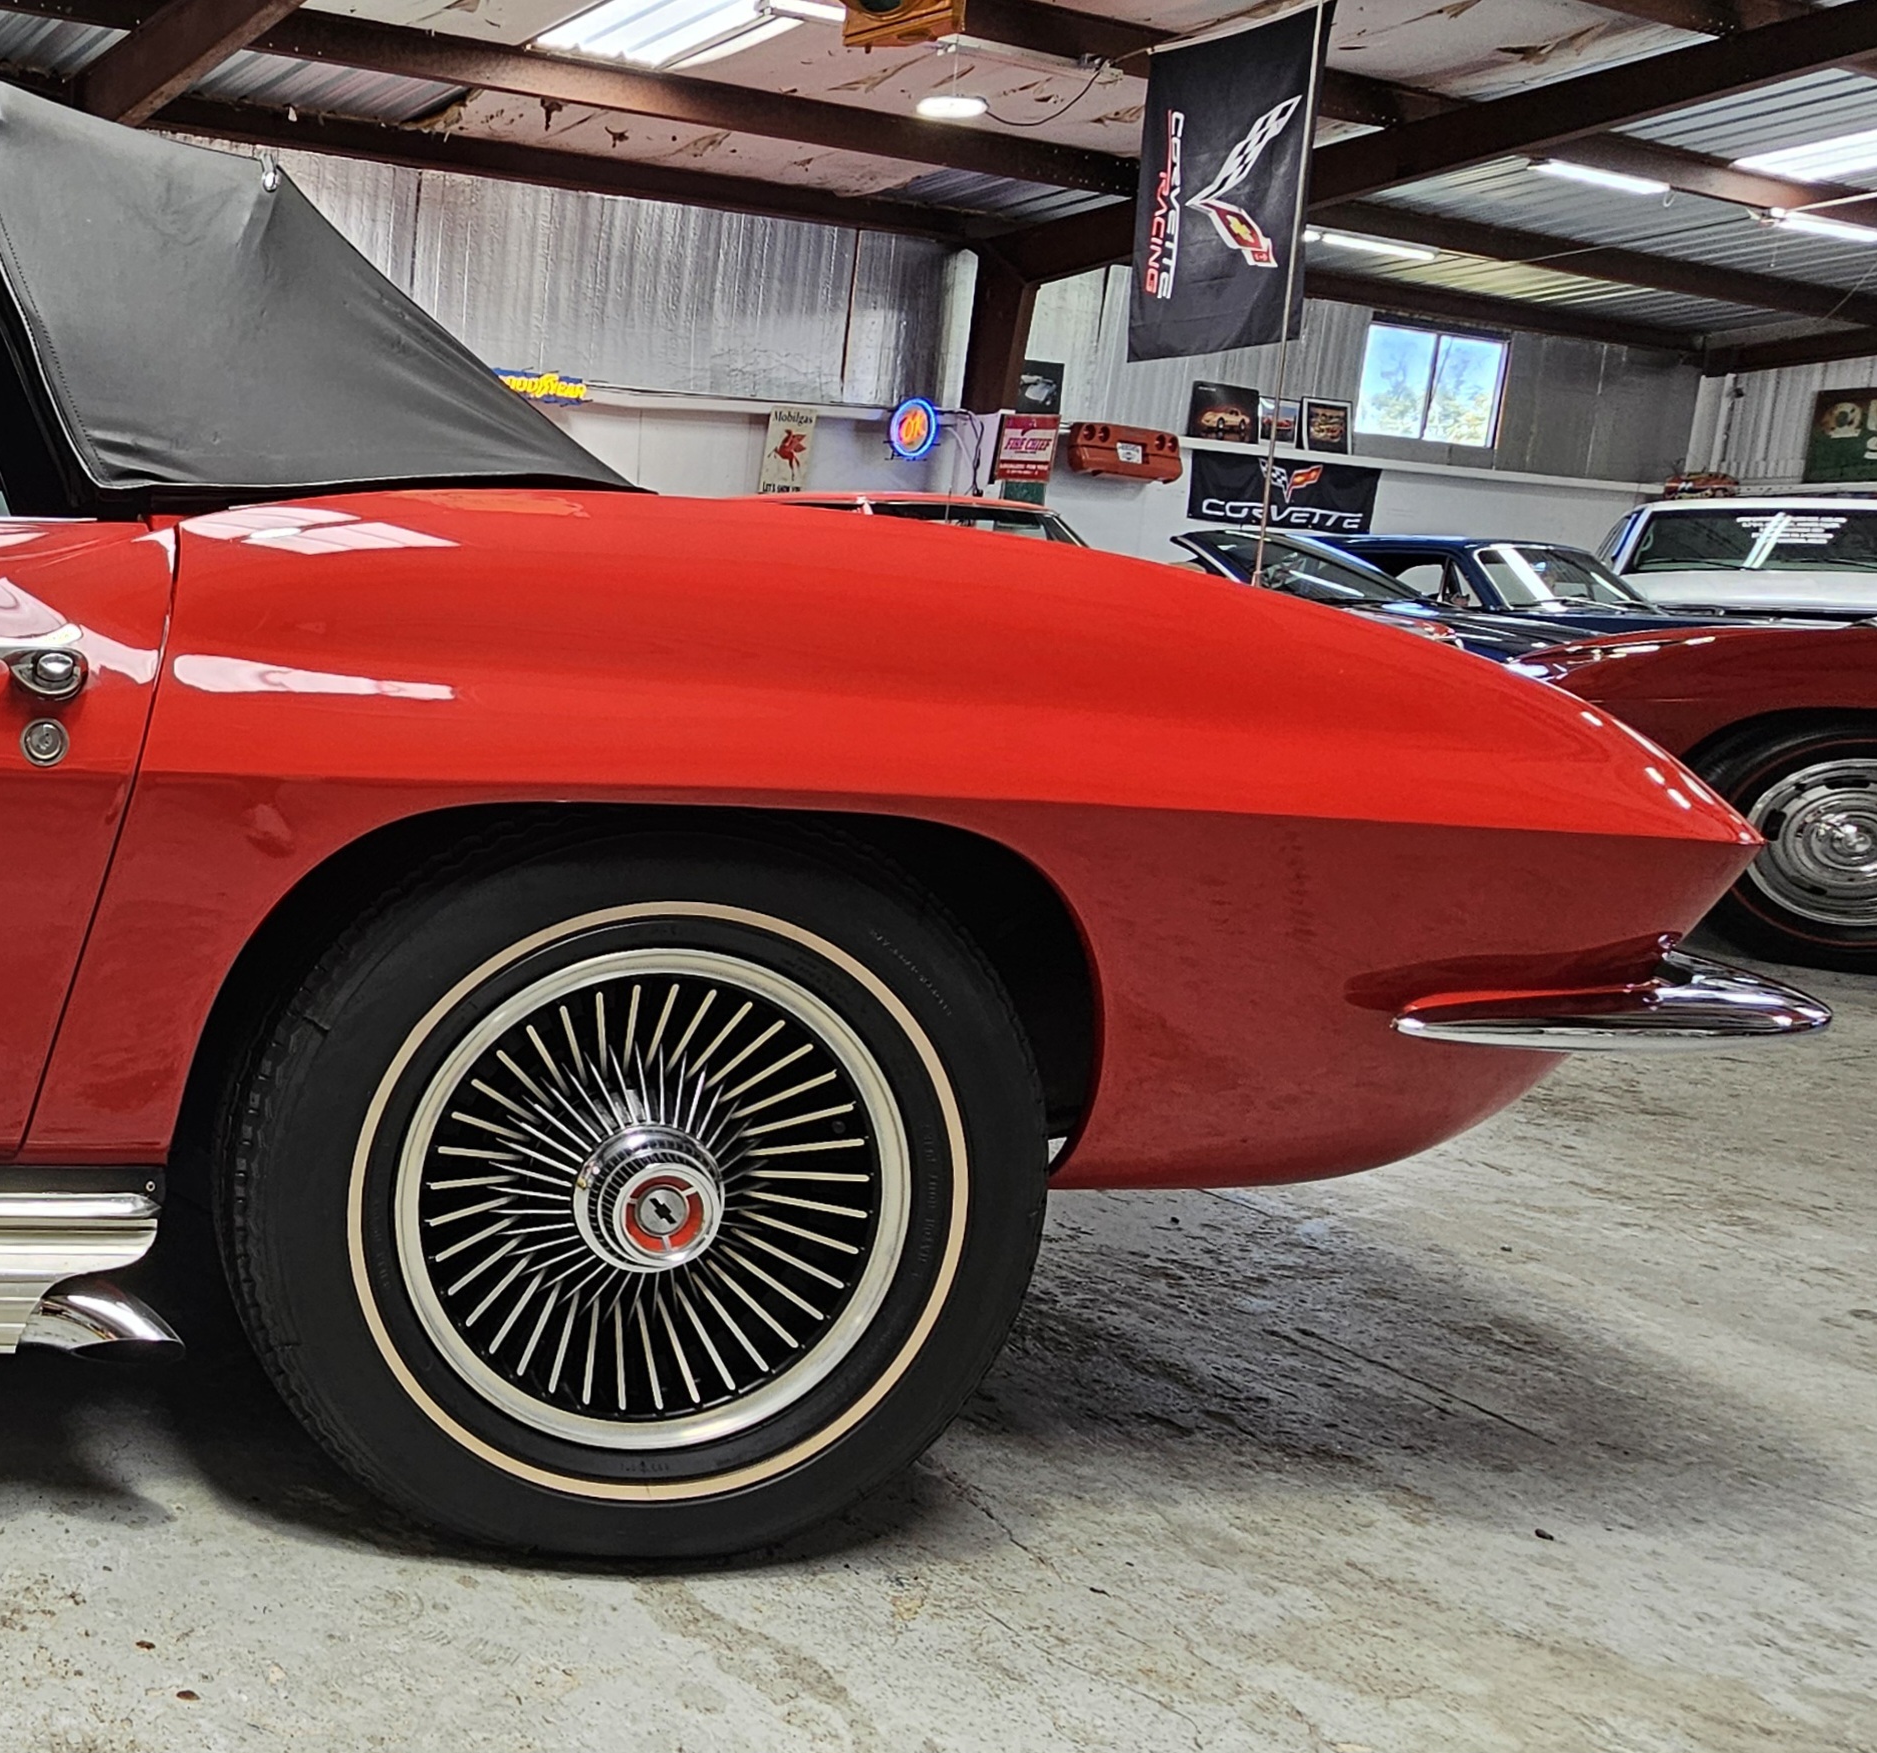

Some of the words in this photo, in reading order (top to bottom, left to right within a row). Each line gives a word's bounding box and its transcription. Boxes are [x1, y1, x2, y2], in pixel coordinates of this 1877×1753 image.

[1157, 111, 1185, 299] CORVETTE
[1145, 165, 1171, 294] RACING
[498, 373, 588, 399] OODYEAR
[774, 410, 814, 427] Mobilgas
[900, 411, 927, 444] OK
[1201, 498, 1364, 531] CORVETTE
